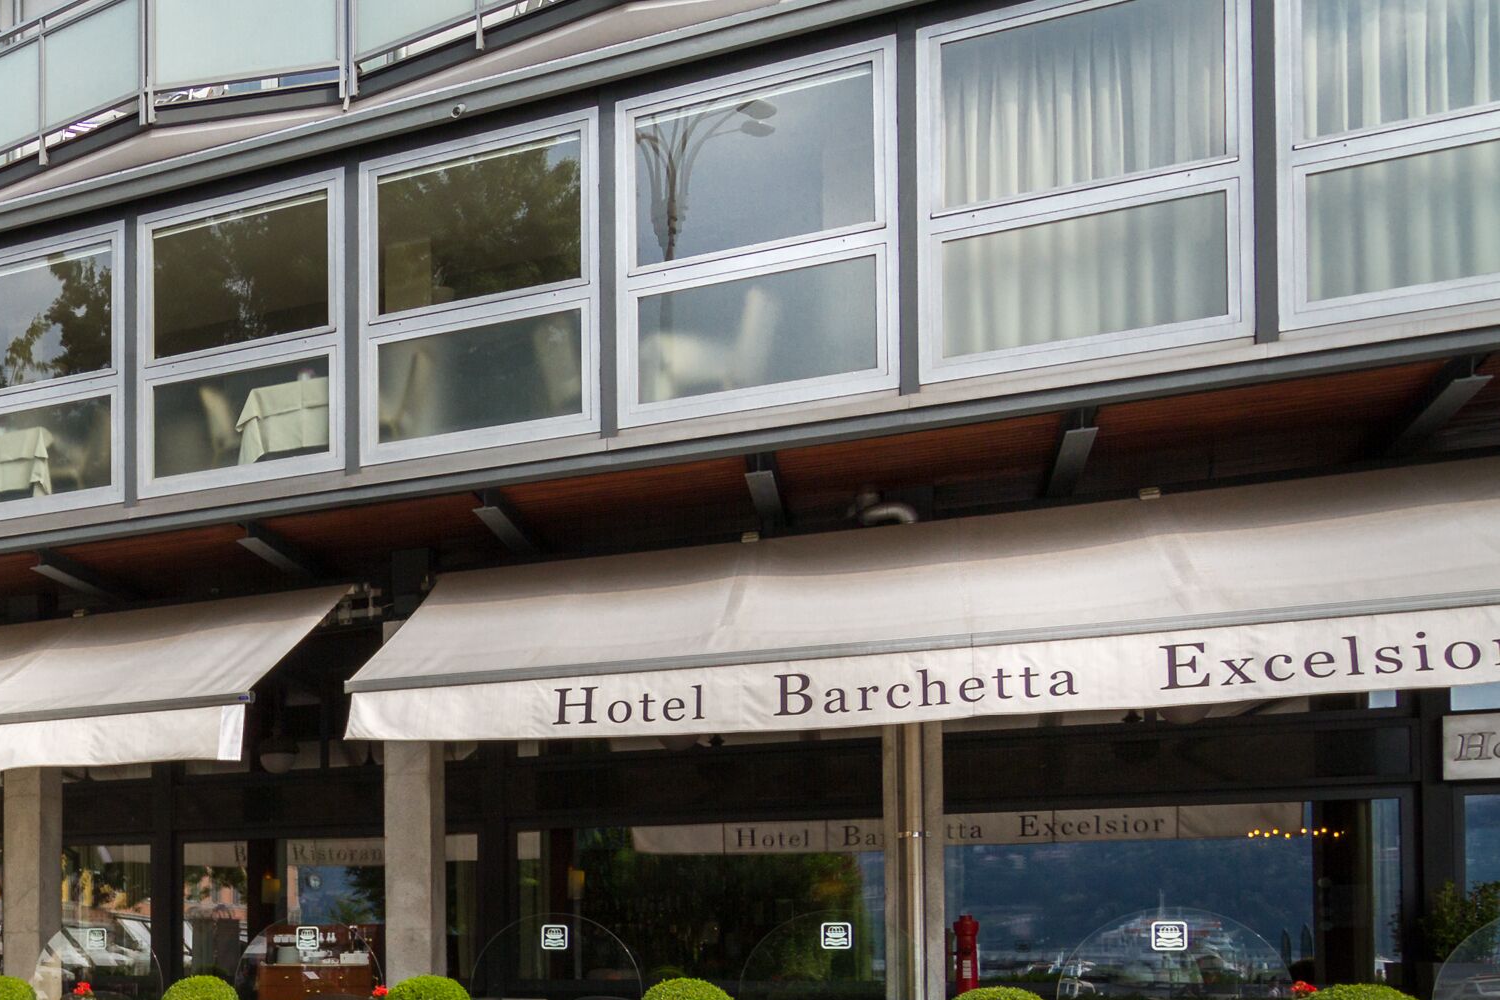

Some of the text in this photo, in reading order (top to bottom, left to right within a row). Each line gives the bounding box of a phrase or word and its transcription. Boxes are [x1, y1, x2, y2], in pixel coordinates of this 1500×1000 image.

[552, 631, 1500, 726] Hotel Barchetta Excelsio
[736, 827, 809, 848] Hotel
[1019, 814, 1166, 838] Excelsior
[292, 842, 383, 861] Ristoran
